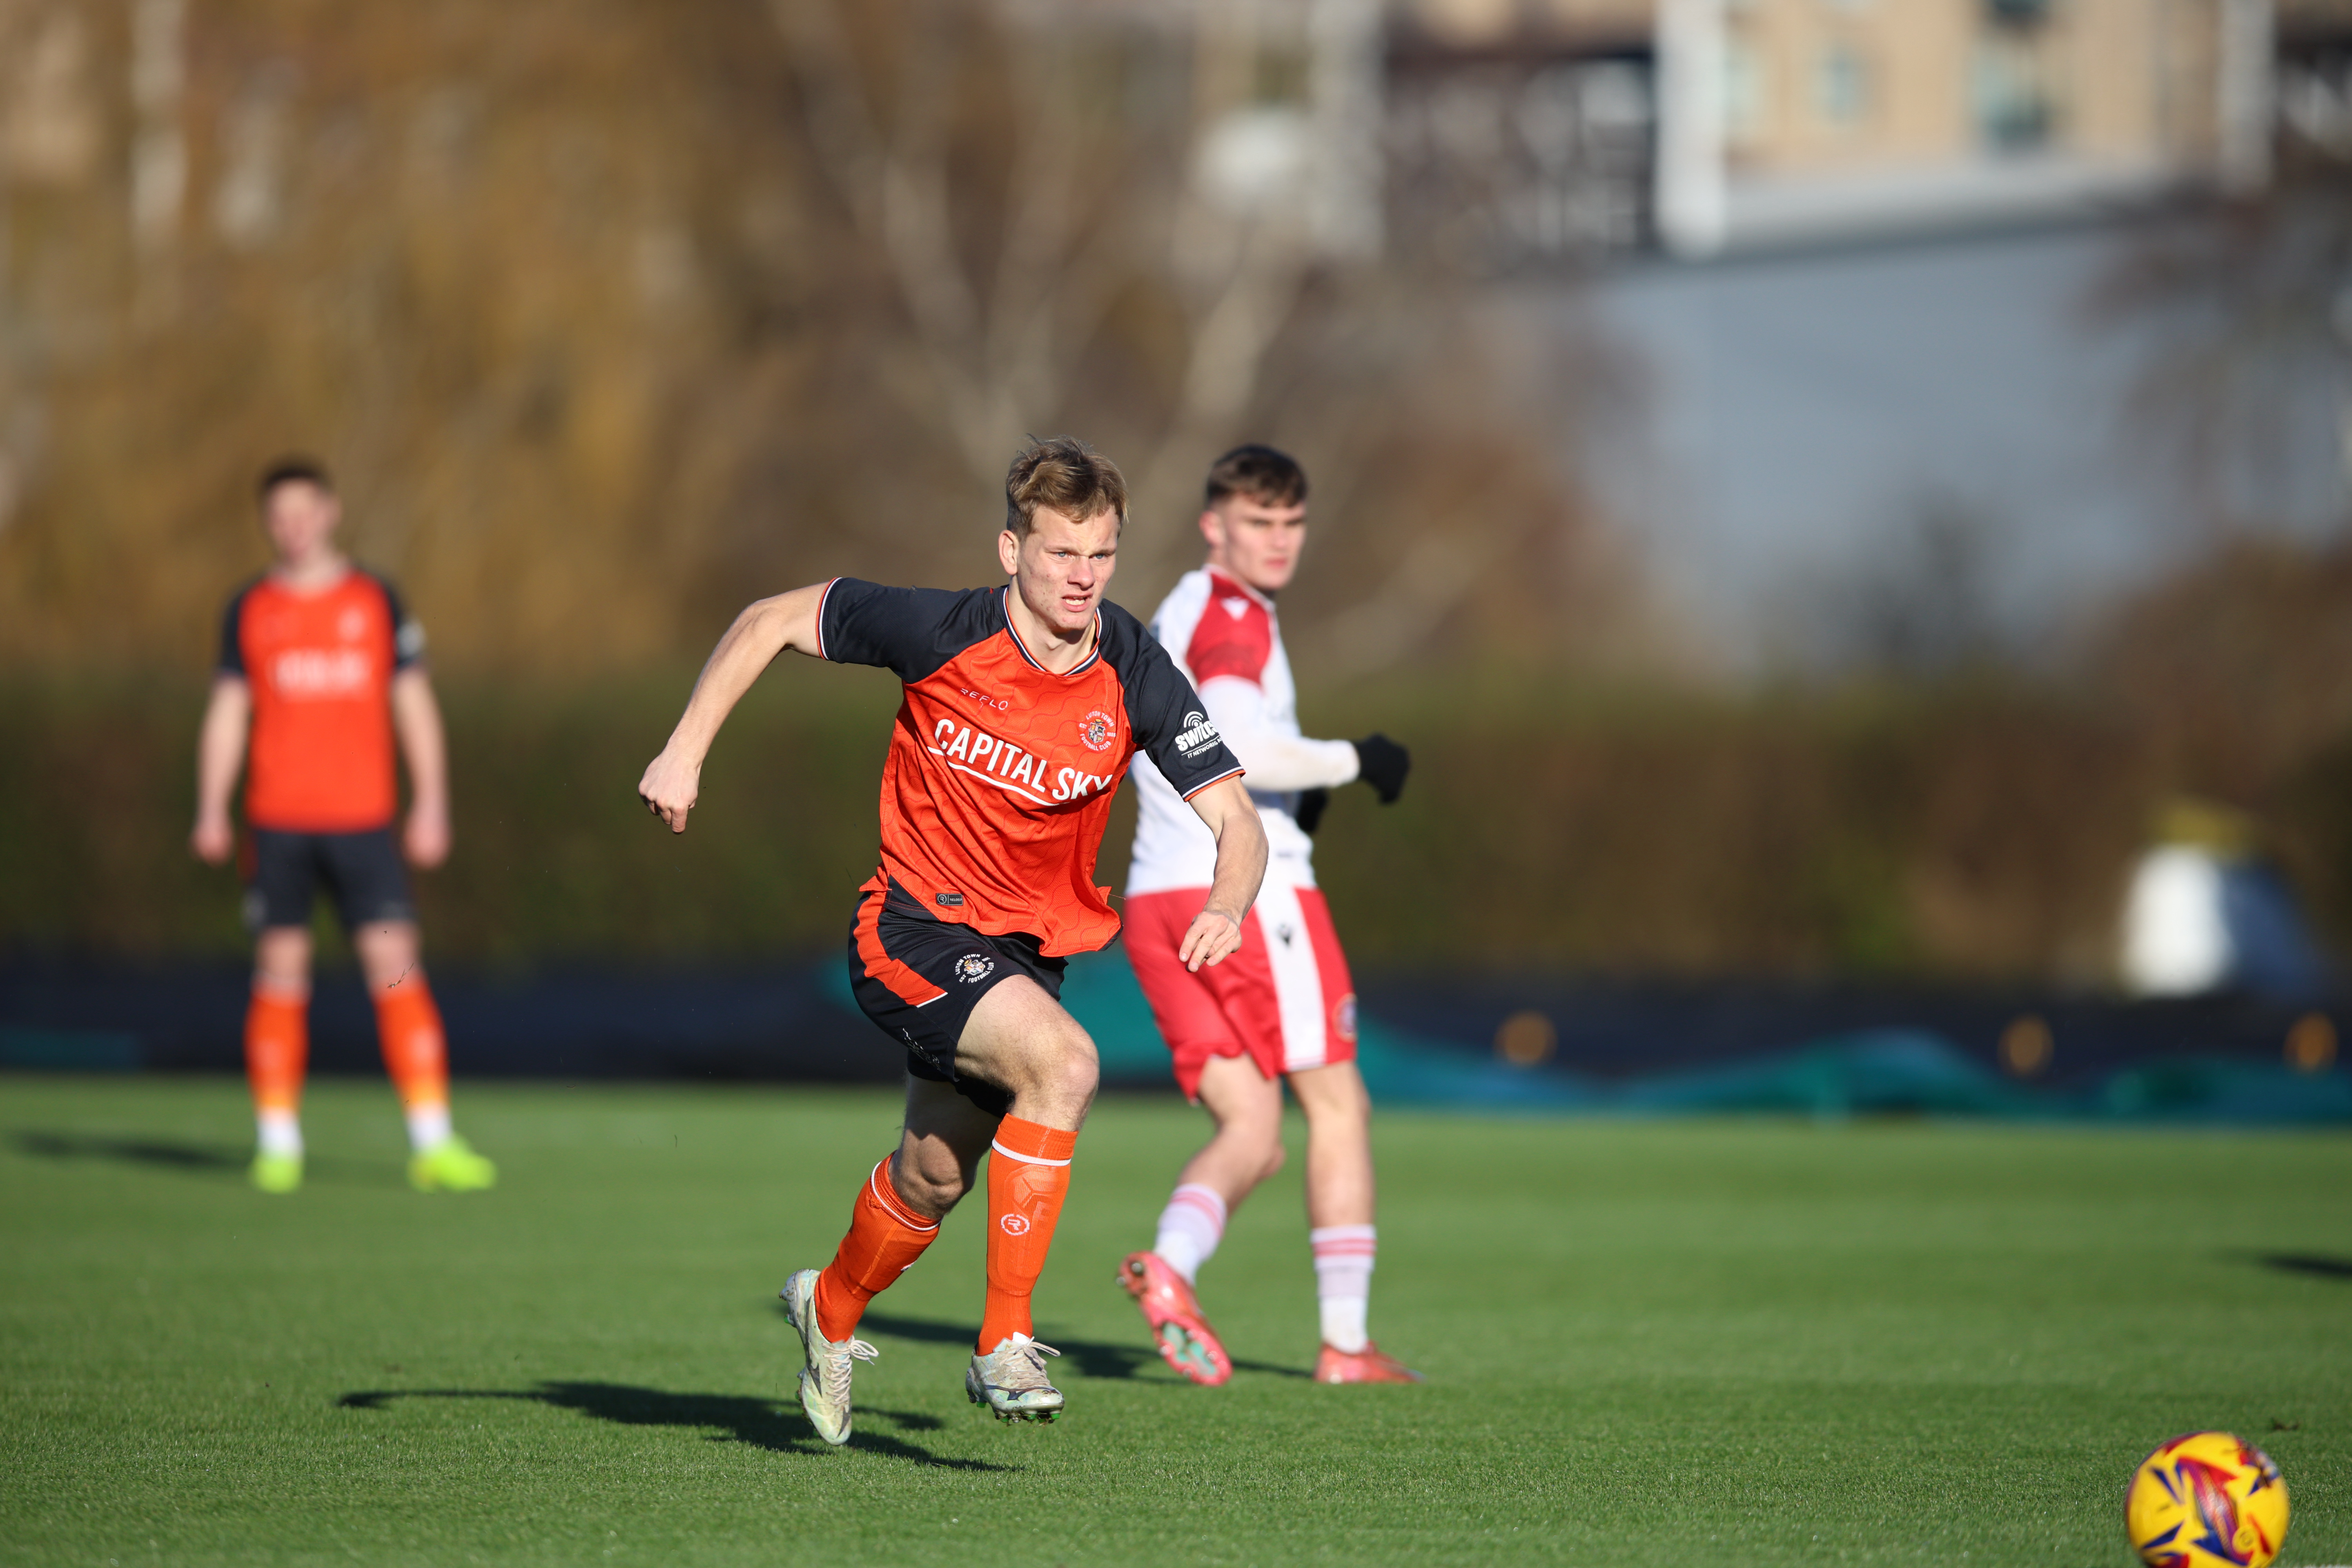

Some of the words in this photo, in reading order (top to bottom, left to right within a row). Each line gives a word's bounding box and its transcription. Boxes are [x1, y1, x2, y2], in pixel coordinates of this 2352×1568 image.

[960, 688, 1008, 710] REFLO
[1086, 711, 1101, 720] LUTON
[1101, 713, 1114, 727] TOWN
[1080, 733, 1099, 751] FOOTBALL
[1099, 741, 1111, 750] CLUB
[935, 719, 1047, 793] CAPITAL
[1052, 768, 1113, 800] SKY
[955, 959, 964, 975] LUTON
[968, 971, 991, 983] FOOTBALL
